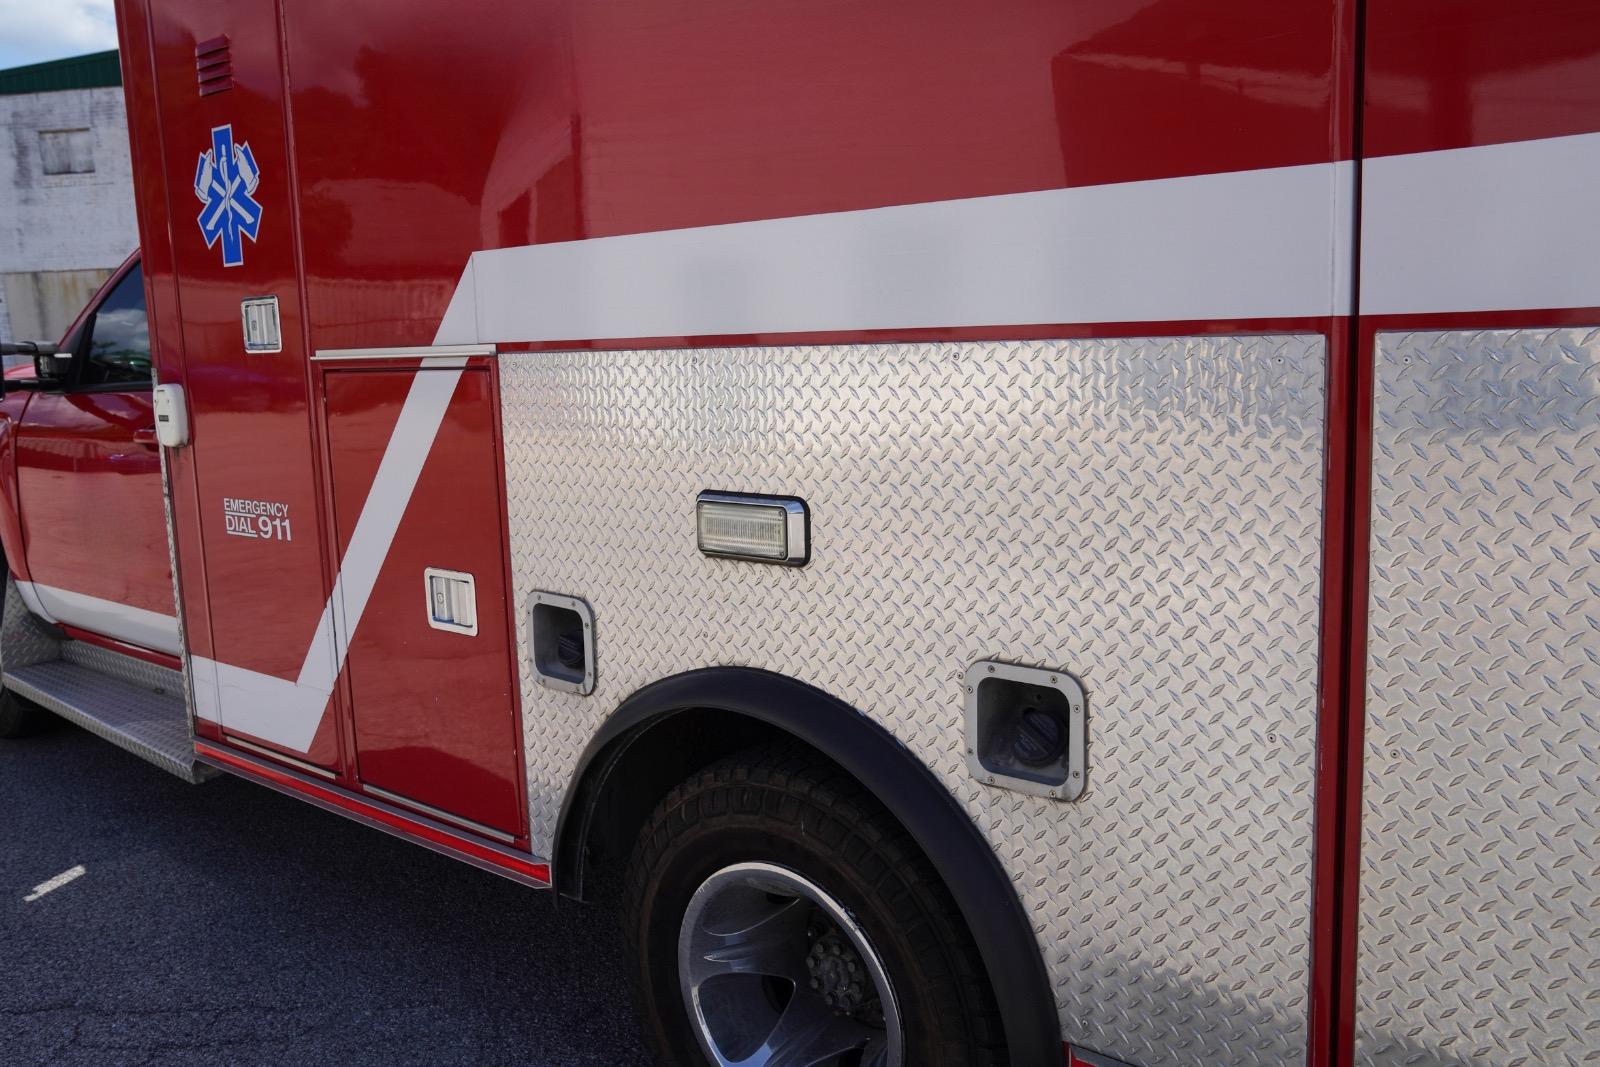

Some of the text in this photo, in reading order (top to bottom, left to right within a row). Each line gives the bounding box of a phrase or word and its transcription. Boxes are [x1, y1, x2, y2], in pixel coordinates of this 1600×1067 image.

[224, 498, 288, 517] EMERGENCY
[226, 516, 291, 541] DIAL 911
